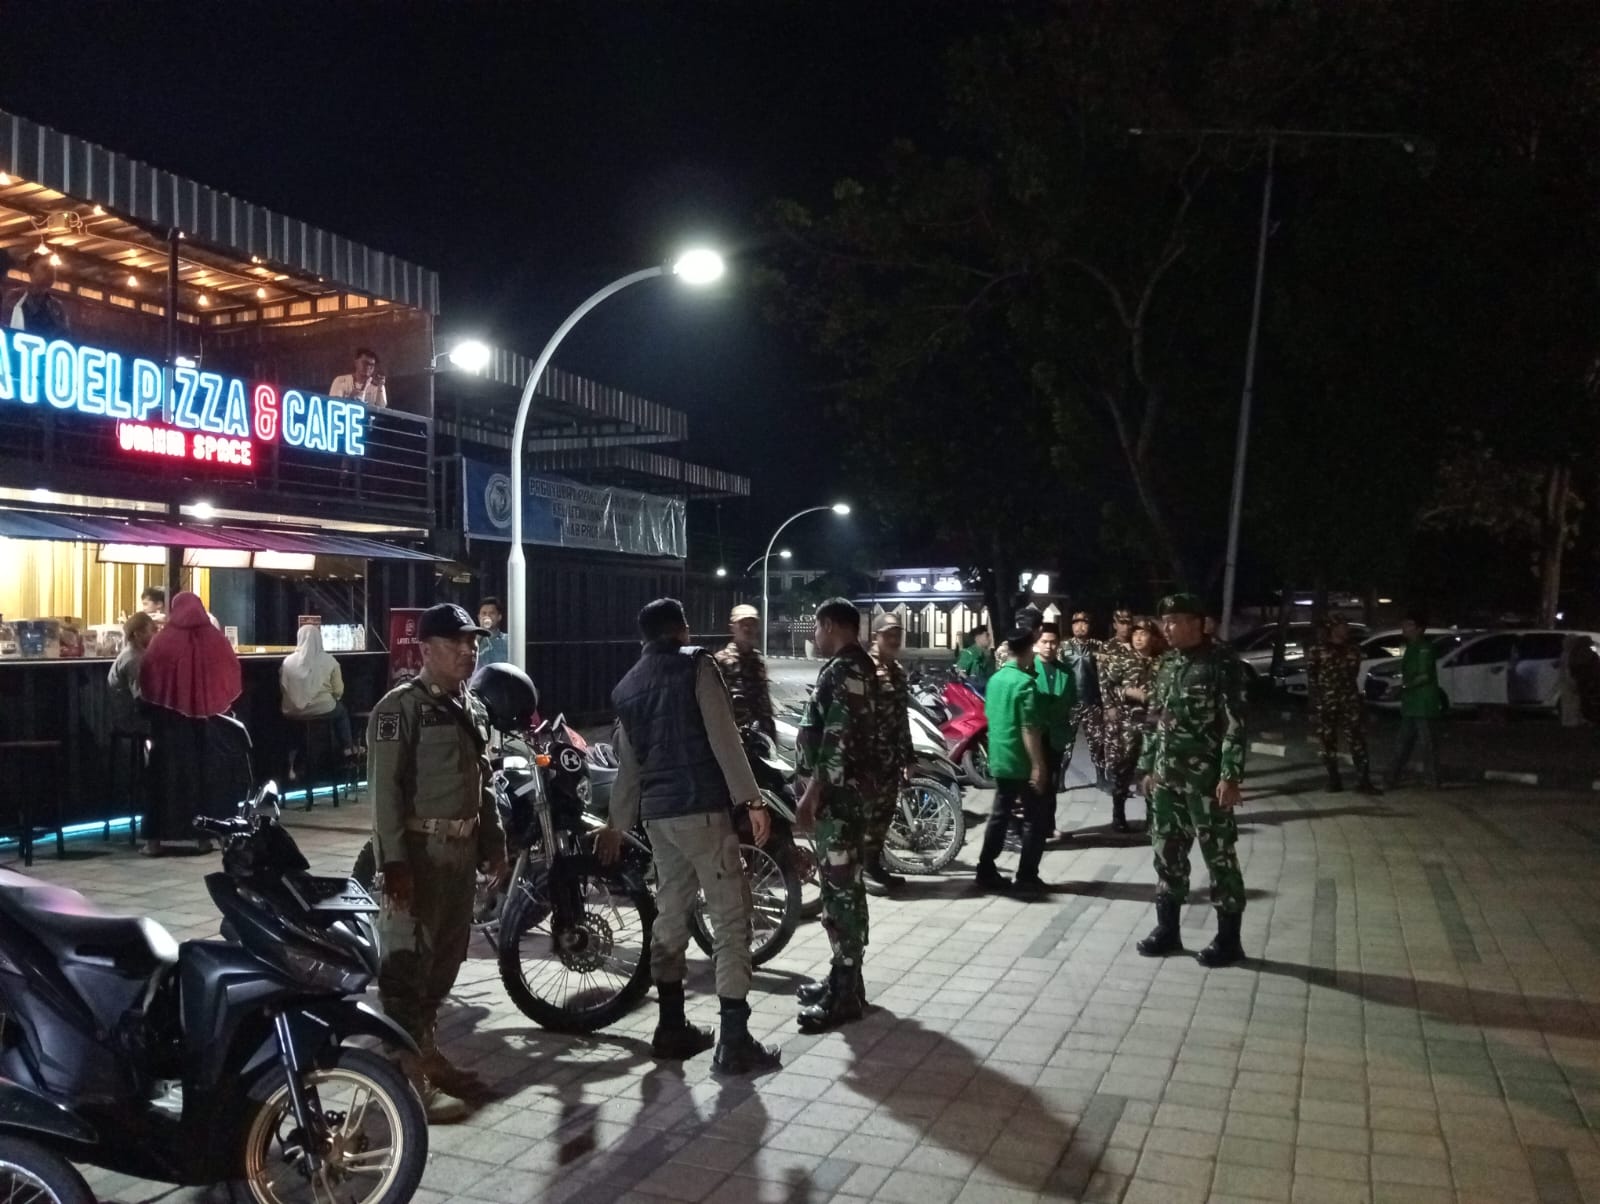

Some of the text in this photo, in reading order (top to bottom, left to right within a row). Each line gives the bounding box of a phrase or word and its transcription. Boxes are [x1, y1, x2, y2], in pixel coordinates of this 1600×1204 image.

[255, 385, 278, 440] &
[282, 390, 365, 455] CAFE
[193, 434, 252, 466] SPACE
